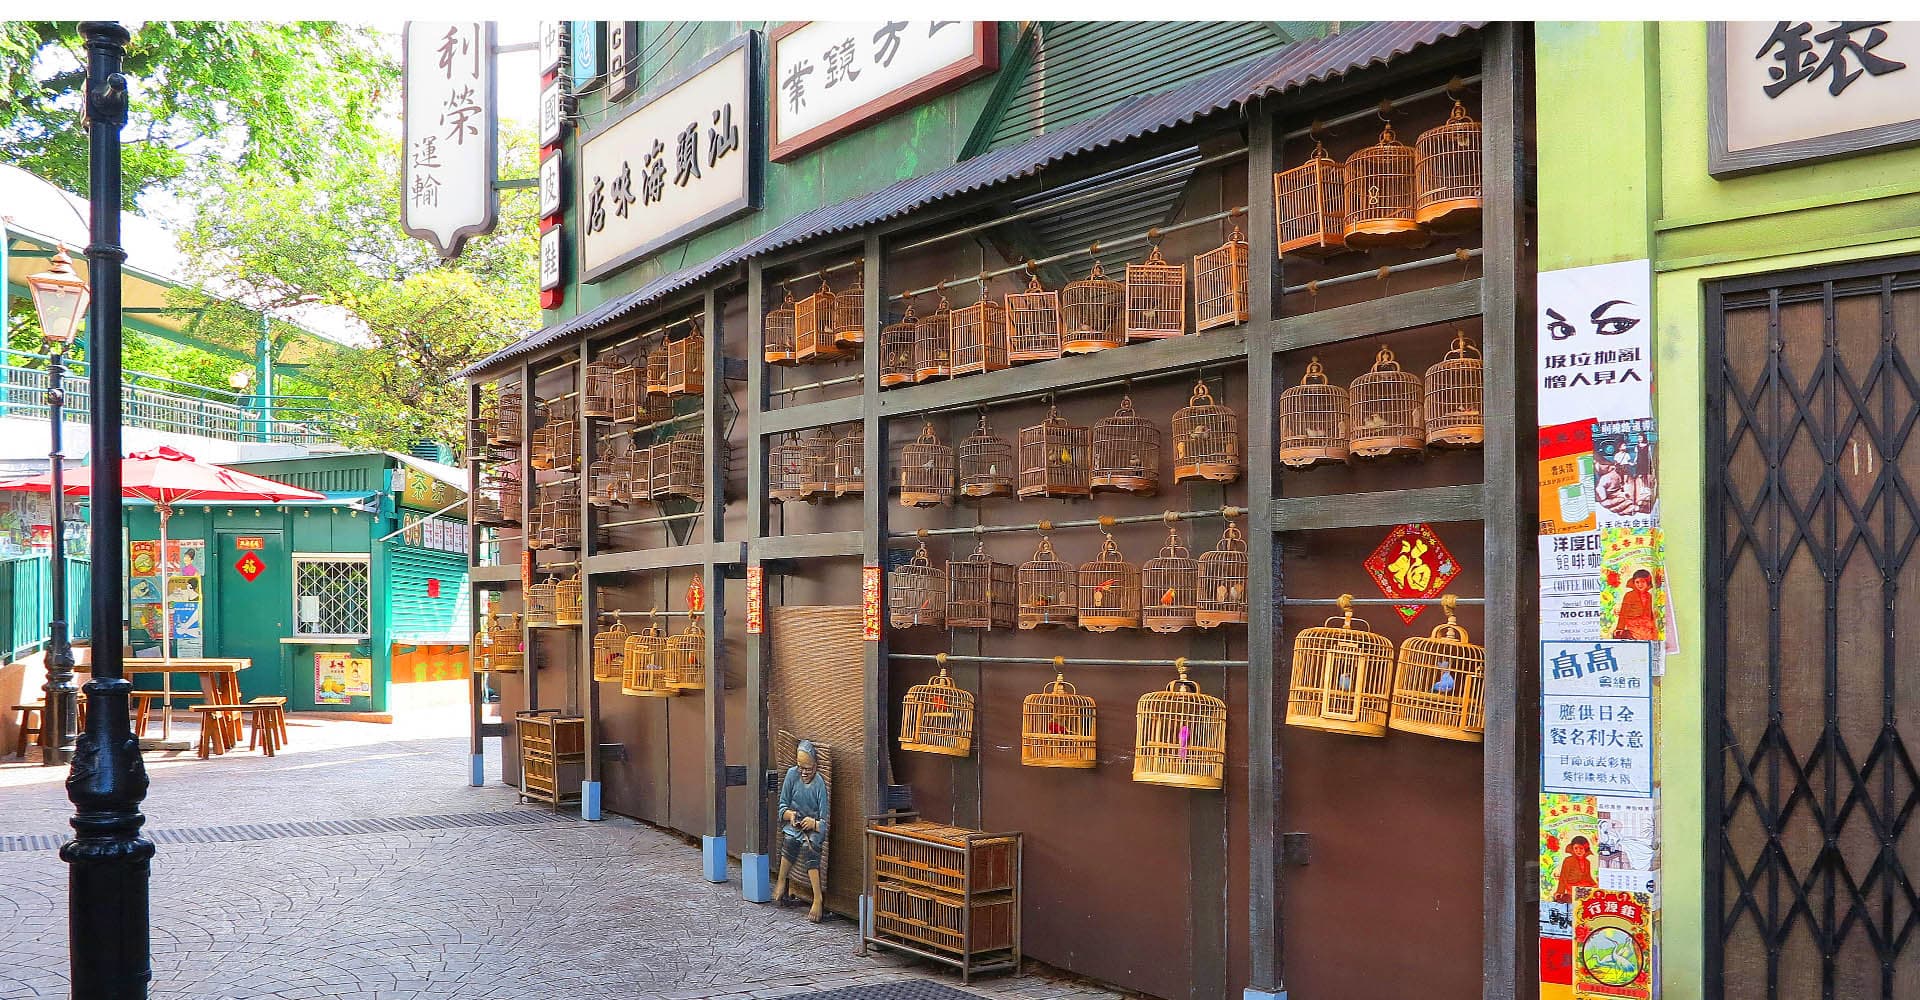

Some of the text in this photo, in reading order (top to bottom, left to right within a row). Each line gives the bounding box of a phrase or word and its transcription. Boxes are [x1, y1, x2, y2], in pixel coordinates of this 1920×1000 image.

[411, 136, 443, 209] 運輸
[242, 559, 257, 575] 福
[1387, 539, 1432, 592] 福
[1560, 610, 1600, 619] MOCHA
